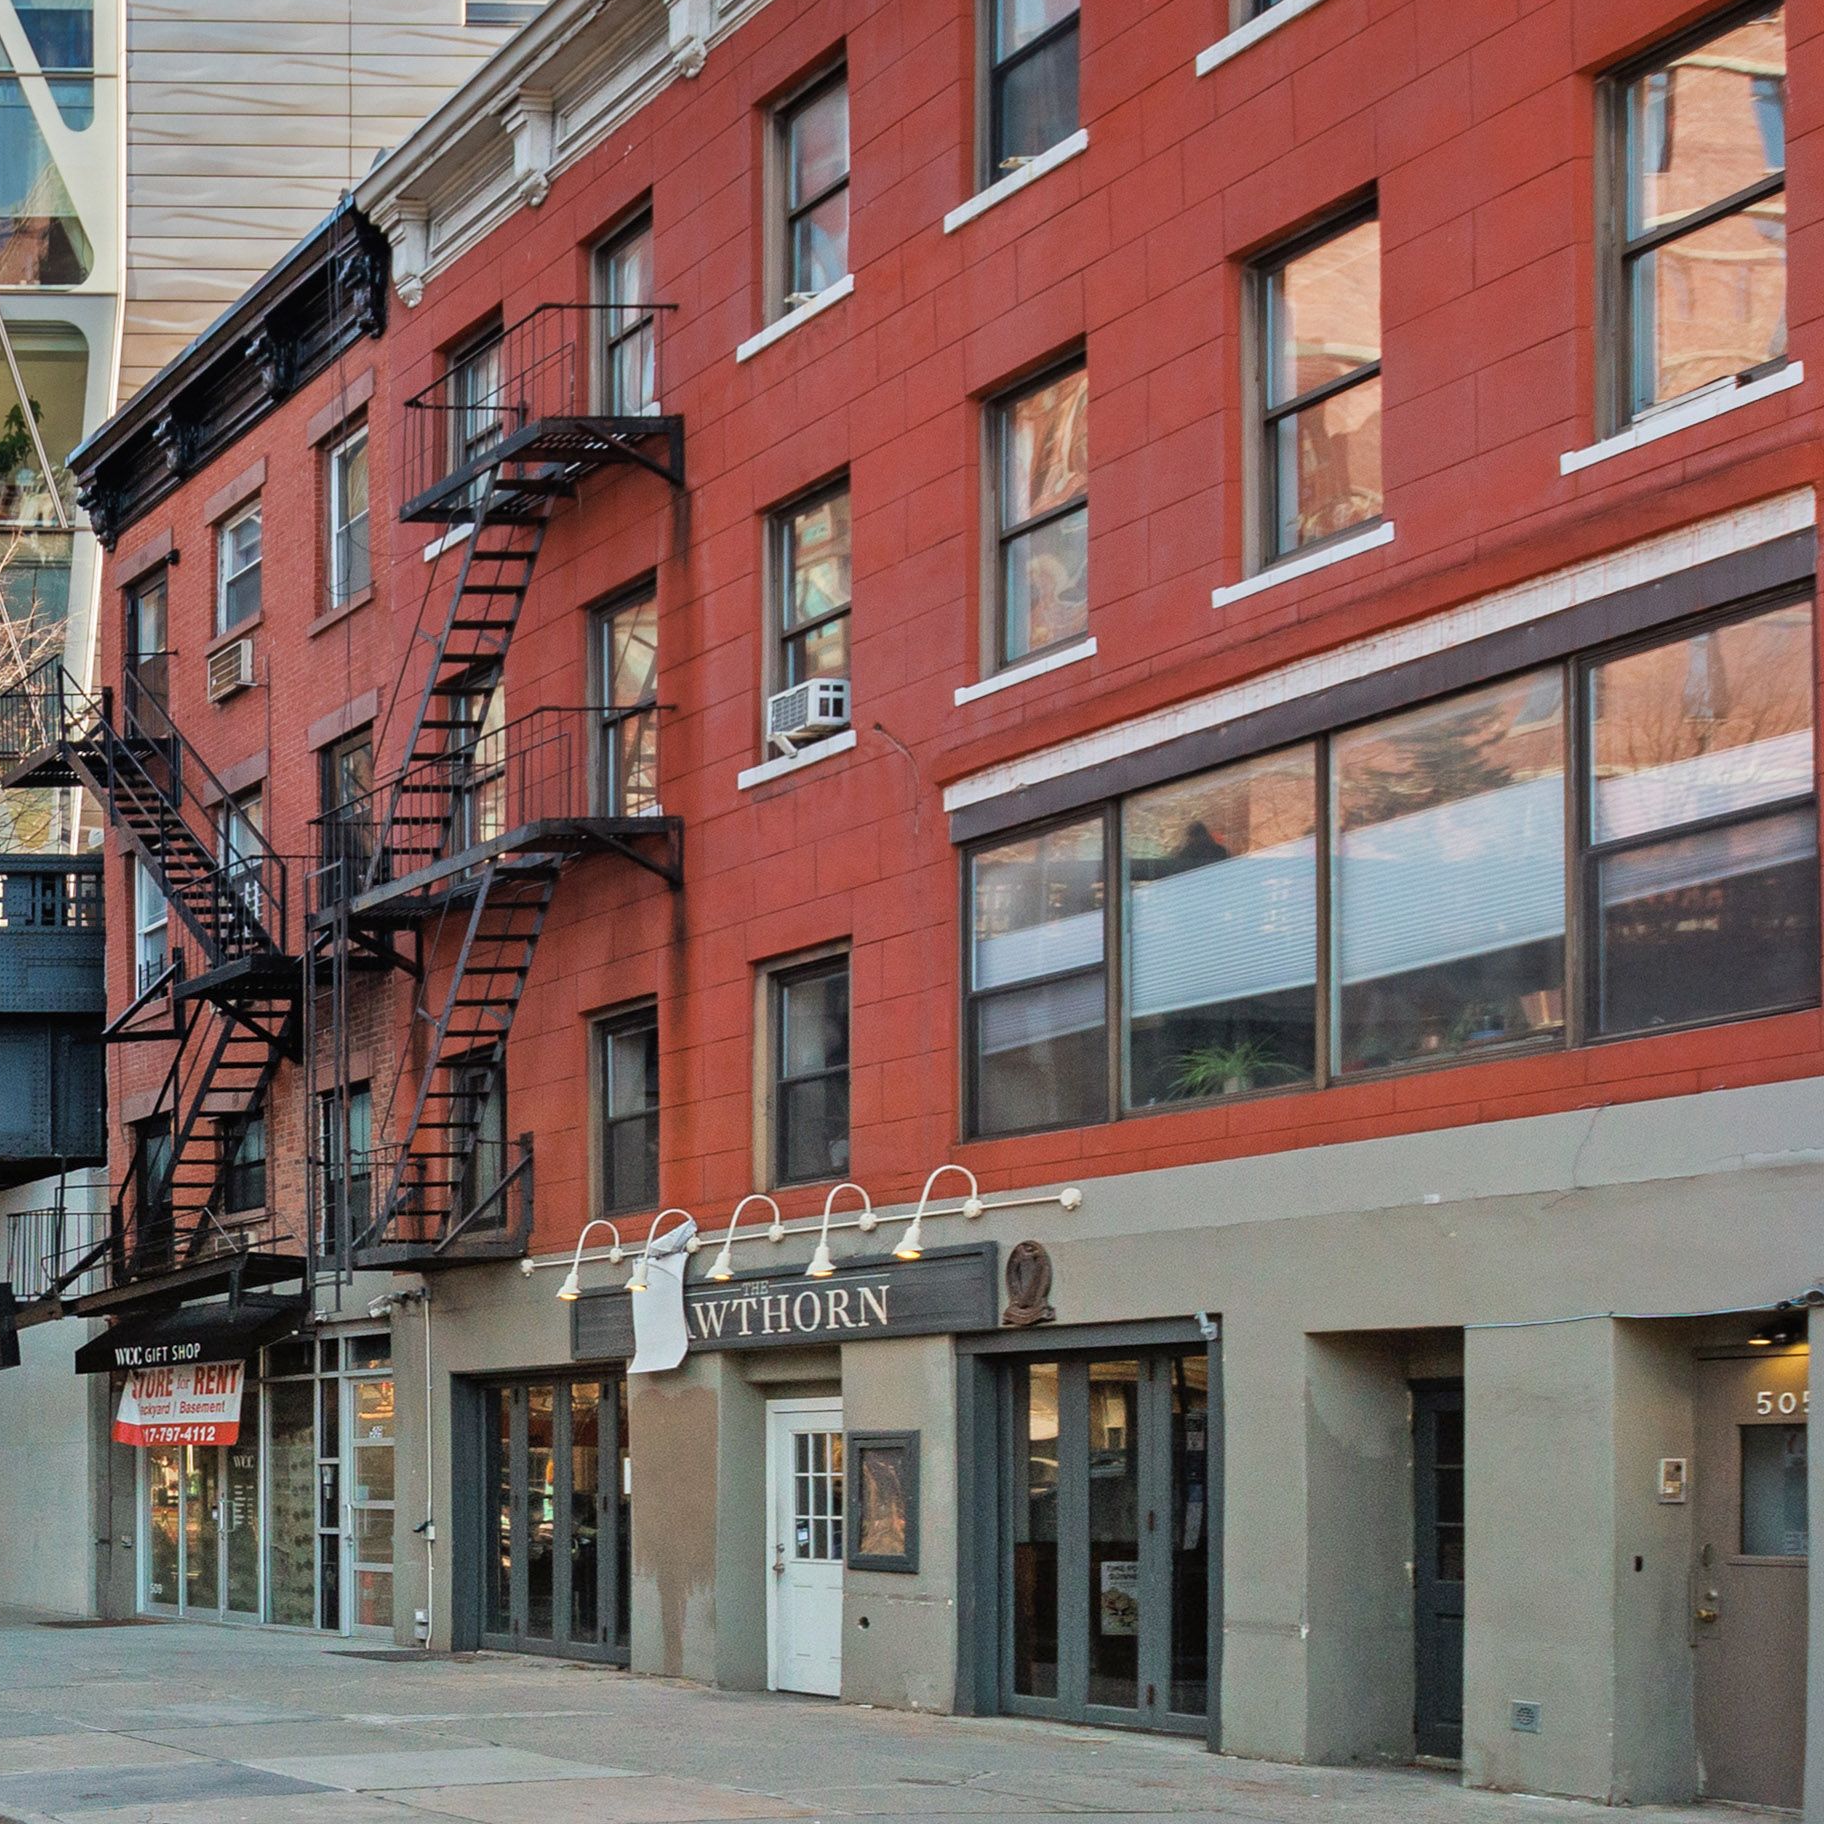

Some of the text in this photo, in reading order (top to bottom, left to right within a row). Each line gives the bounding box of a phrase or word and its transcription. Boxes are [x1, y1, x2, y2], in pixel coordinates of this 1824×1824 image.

[742, 1280, 770, 1297] THE
[115, 1342, 201, 1366] WCC GIFT SHOP
[131, 1363, 240, 1400] STORE for RENT
[138, 1400, 226, 1418] ackyard Basement
[143, 1425, 216, 1443] 17-797-4112
